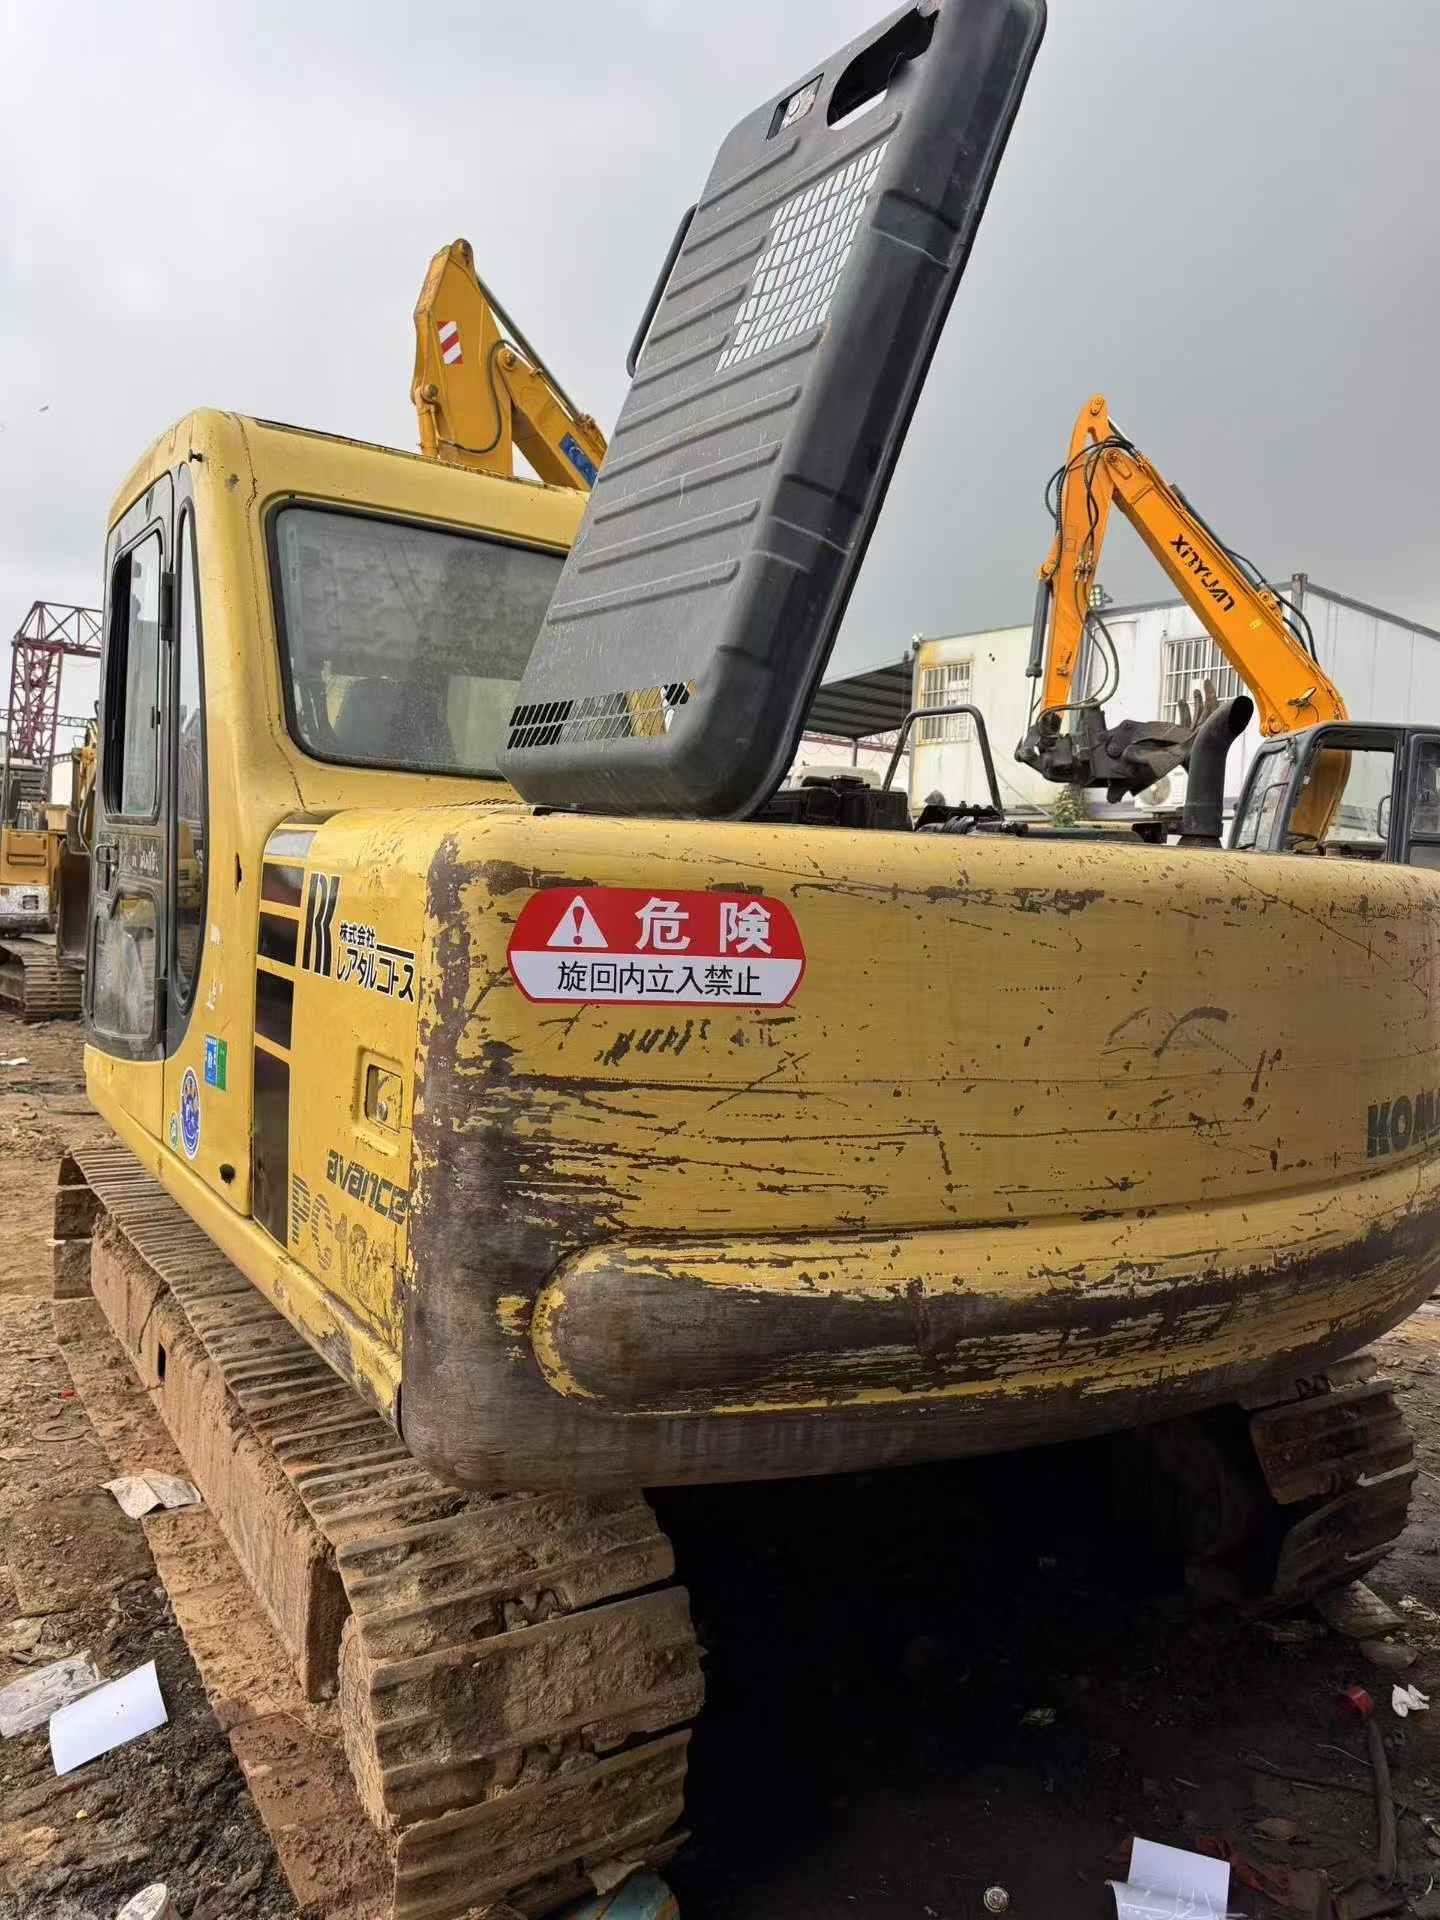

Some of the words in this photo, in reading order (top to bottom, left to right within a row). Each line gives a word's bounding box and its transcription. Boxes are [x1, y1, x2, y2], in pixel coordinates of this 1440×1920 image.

[635, 896, 773, 954] 危険
[557, 960, 762, 997] 旋回内立入禁止
